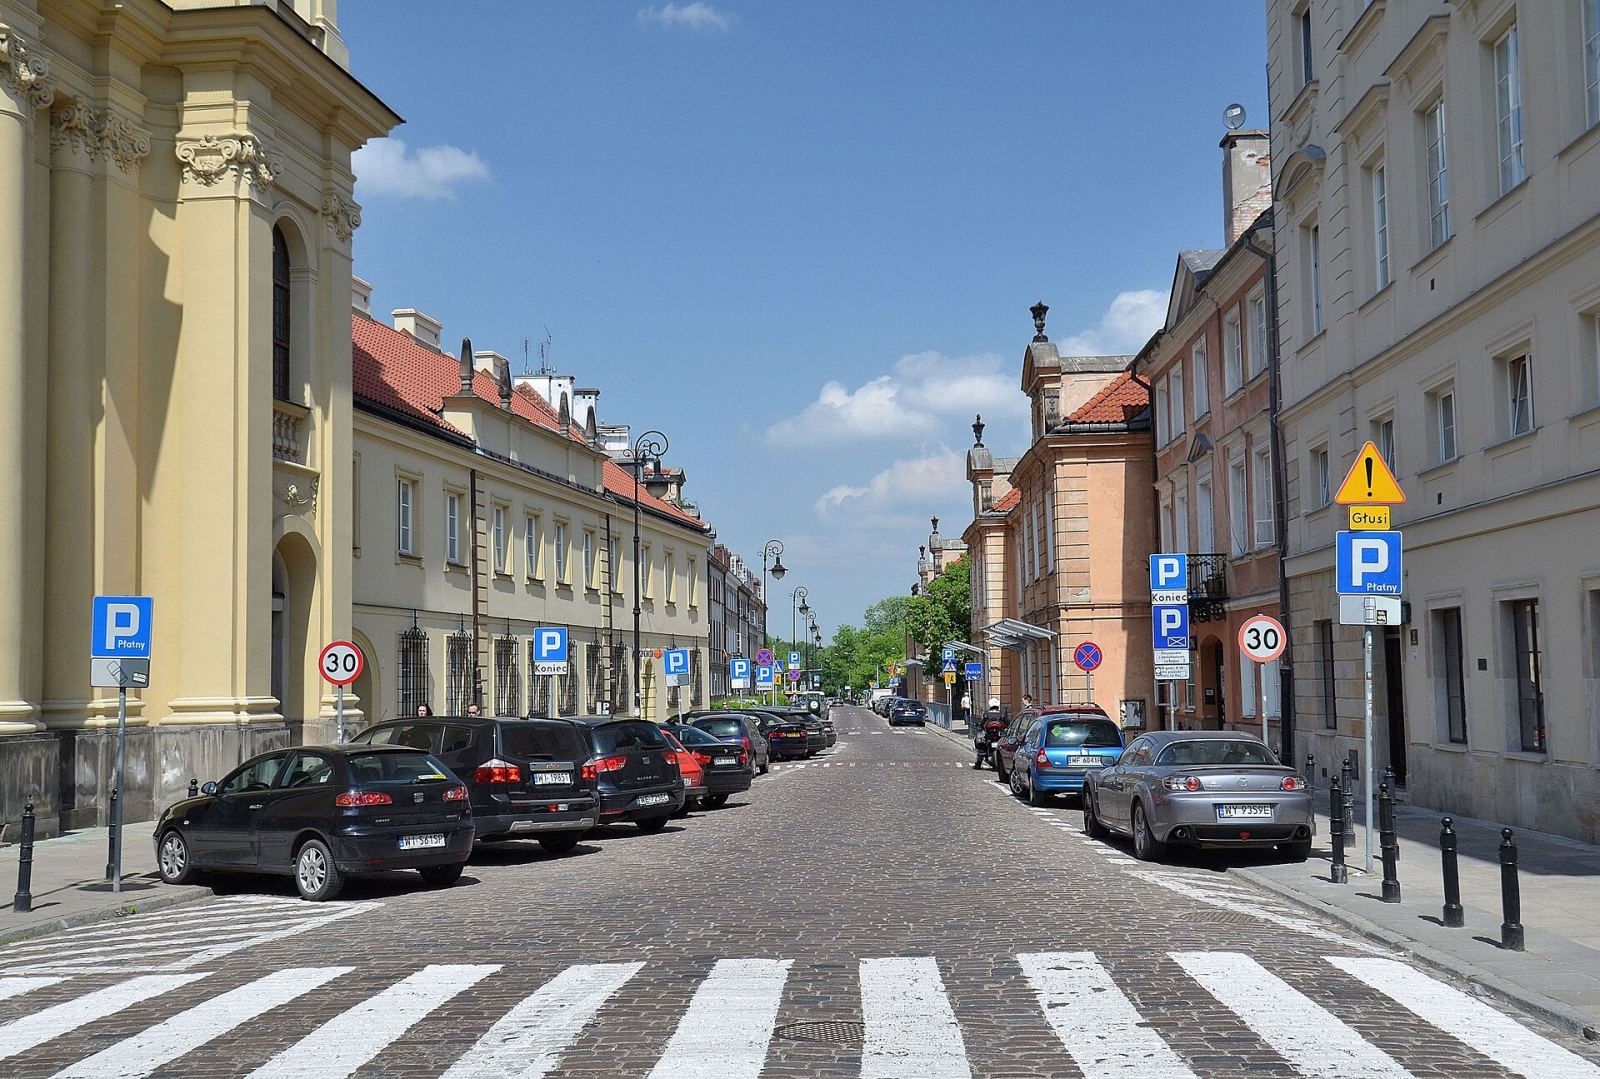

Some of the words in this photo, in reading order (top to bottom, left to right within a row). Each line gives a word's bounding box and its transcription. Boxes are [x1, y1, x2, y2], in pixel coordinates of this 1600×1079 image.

[1352, 512, 1387, 524] Głusi
[1351, 538, 1389, 587] P
[1158, 558, 1180, 586] P
[1366, 582, 1398, 593] Płatny
[1152, 593, 1187, 602] Koniec
[105, 603, 140, 650] P
[1160, 608, 1182, 637] P
[117, 639, 145, 651] Płatny
[541, 631, 561, 658] P
[1246, 627, 1279, 650] 30
[669, 652, 683, 672] P
[791, 653, 798, 662] P
[945, 650, 952, 659] P
[326, 652, 356, 673] 30
[535, 664, 567, 673] Koniec
[734, 661, 747, 677] P
[760, 667, 770, 681] P
[1224, 804, 1238, 815] WY
[1241, 804, 1270, 815] 9359E
